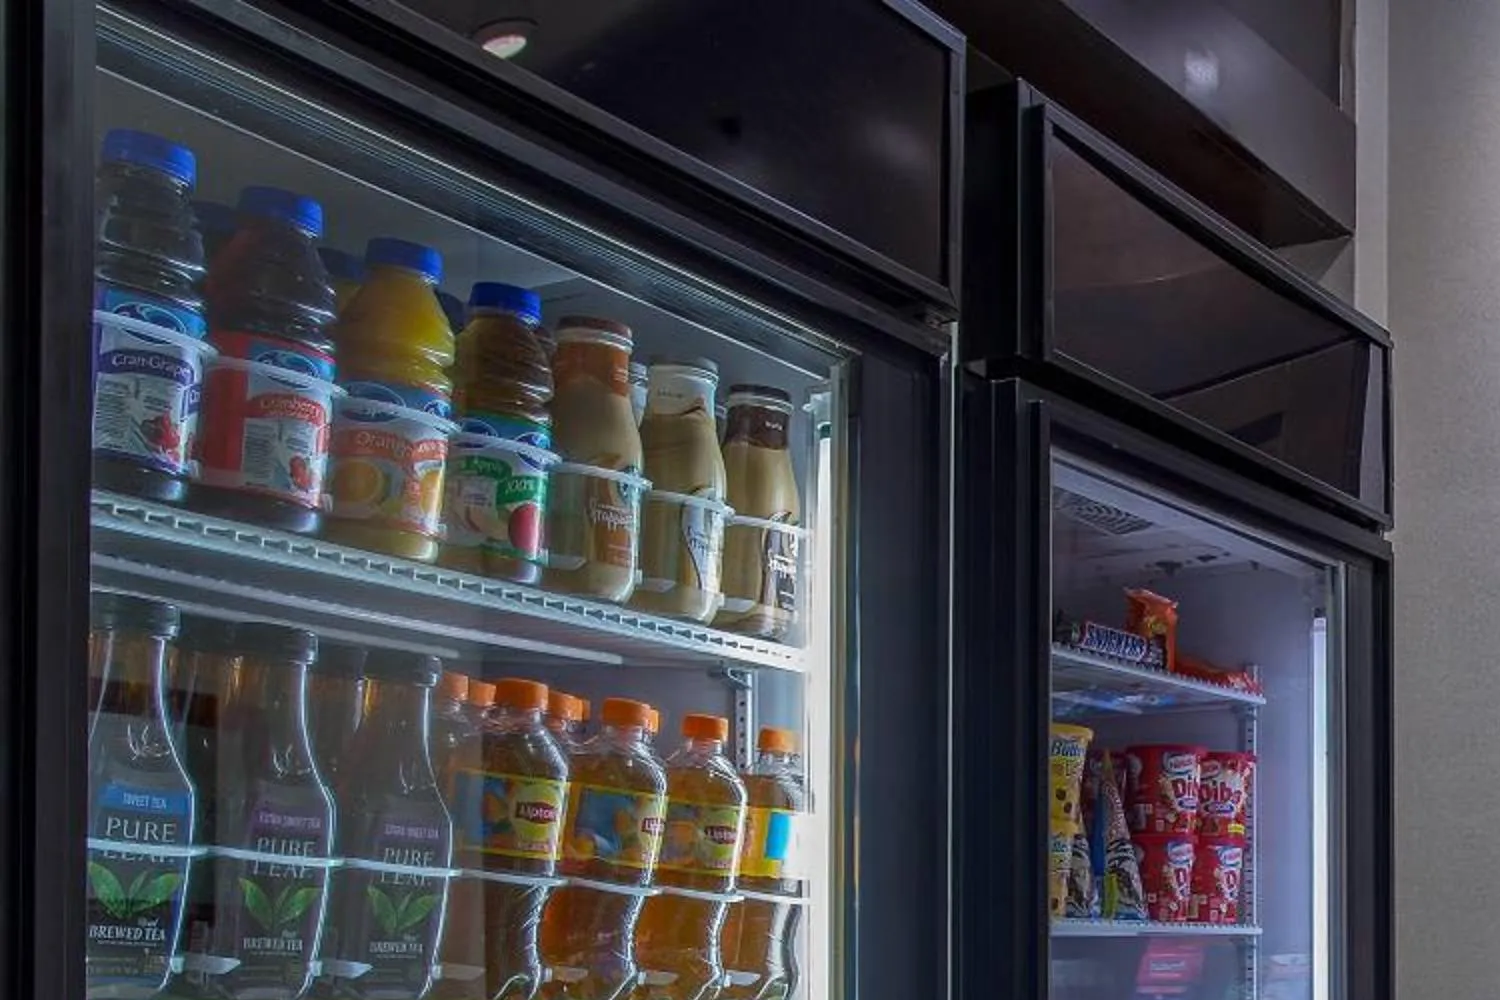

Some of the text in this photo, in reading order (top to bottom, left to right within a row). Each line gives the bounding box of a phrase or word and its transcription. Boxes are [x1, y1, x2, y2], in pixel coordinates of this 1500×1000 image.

[105, 816, 177, 843] PURE
[256, 837, 316, 858] PURE
[384, 847, 435, 867] PURE
[89, 925, 166, 942] BREWED TEA
